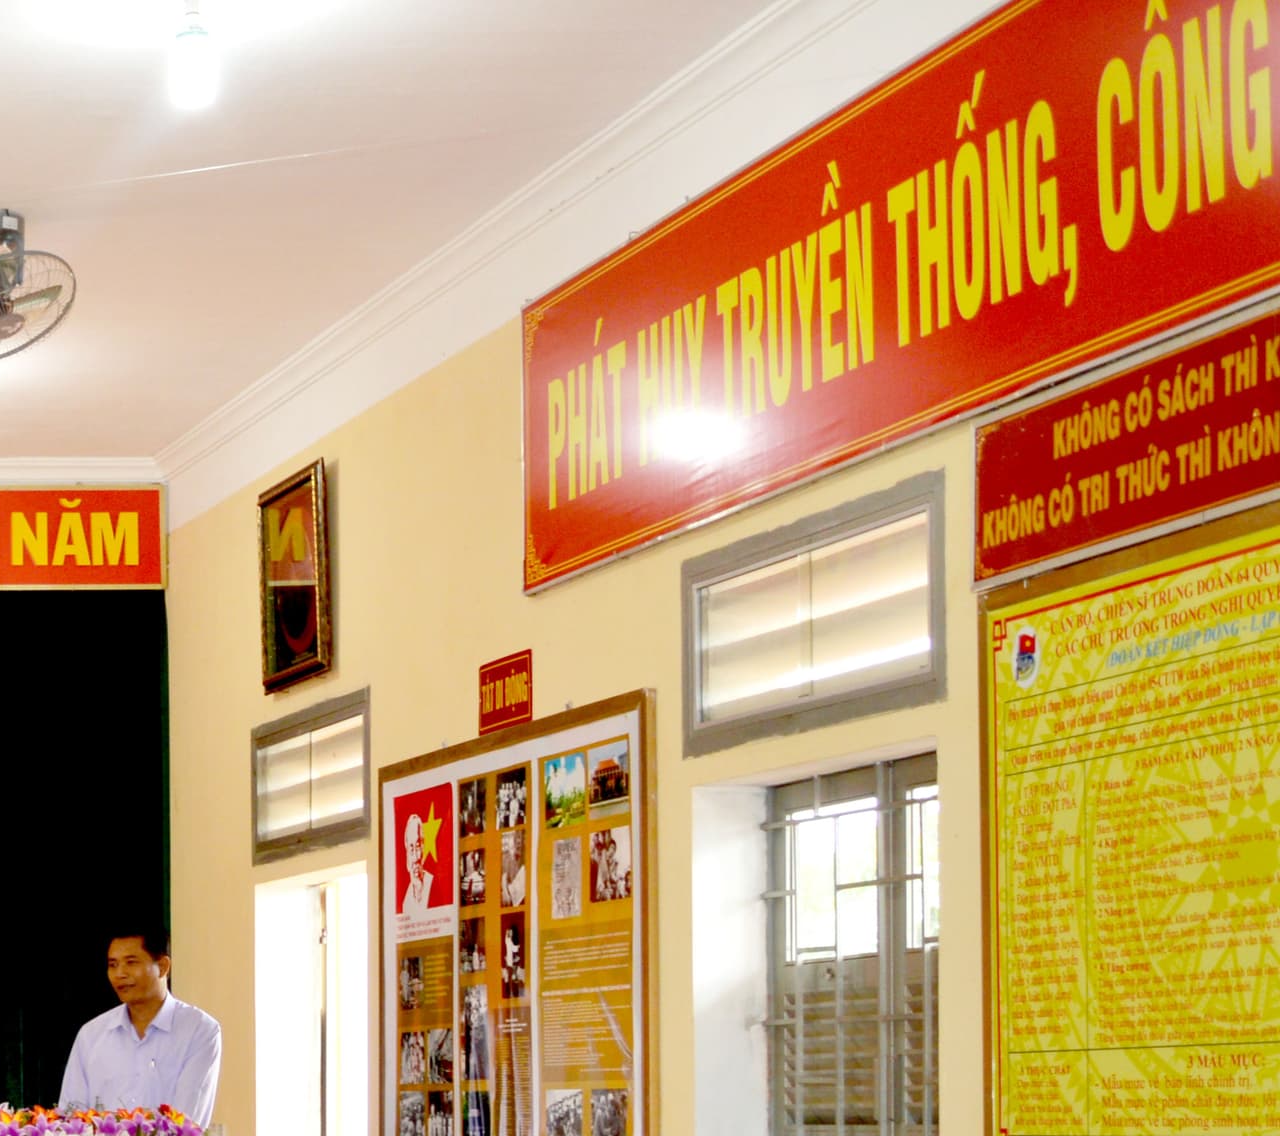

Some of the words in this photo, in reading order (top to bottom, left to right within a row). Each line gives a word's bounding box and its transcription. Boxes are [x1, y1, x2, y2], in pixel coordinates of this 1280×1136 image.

[548, 317, 626, 510] PHÁT
[716, 160, 875, 420] TRUYỀN
[887, 69, 1078, 307] THỐNG,
[1096, 0, 1273, 252] CÔNG
[1053, 401, 1120, 460] KHÔNG
[1125, 374, 1152, 433] CÓ
[1157, 363, 1214, 421] SÁCH
[1221, 334, 1258, 396] THÌ
[11, 497, 139, 566] NĂM
[982, 494, 1045, 549] KHÔNG
[1048, 472, 1074, 527] CÓ
[1078, 471, 1109, 517] TRI
[1116, 444, 1170, 504] THỨC
[1175, 425, 1211, 485] THÌ
